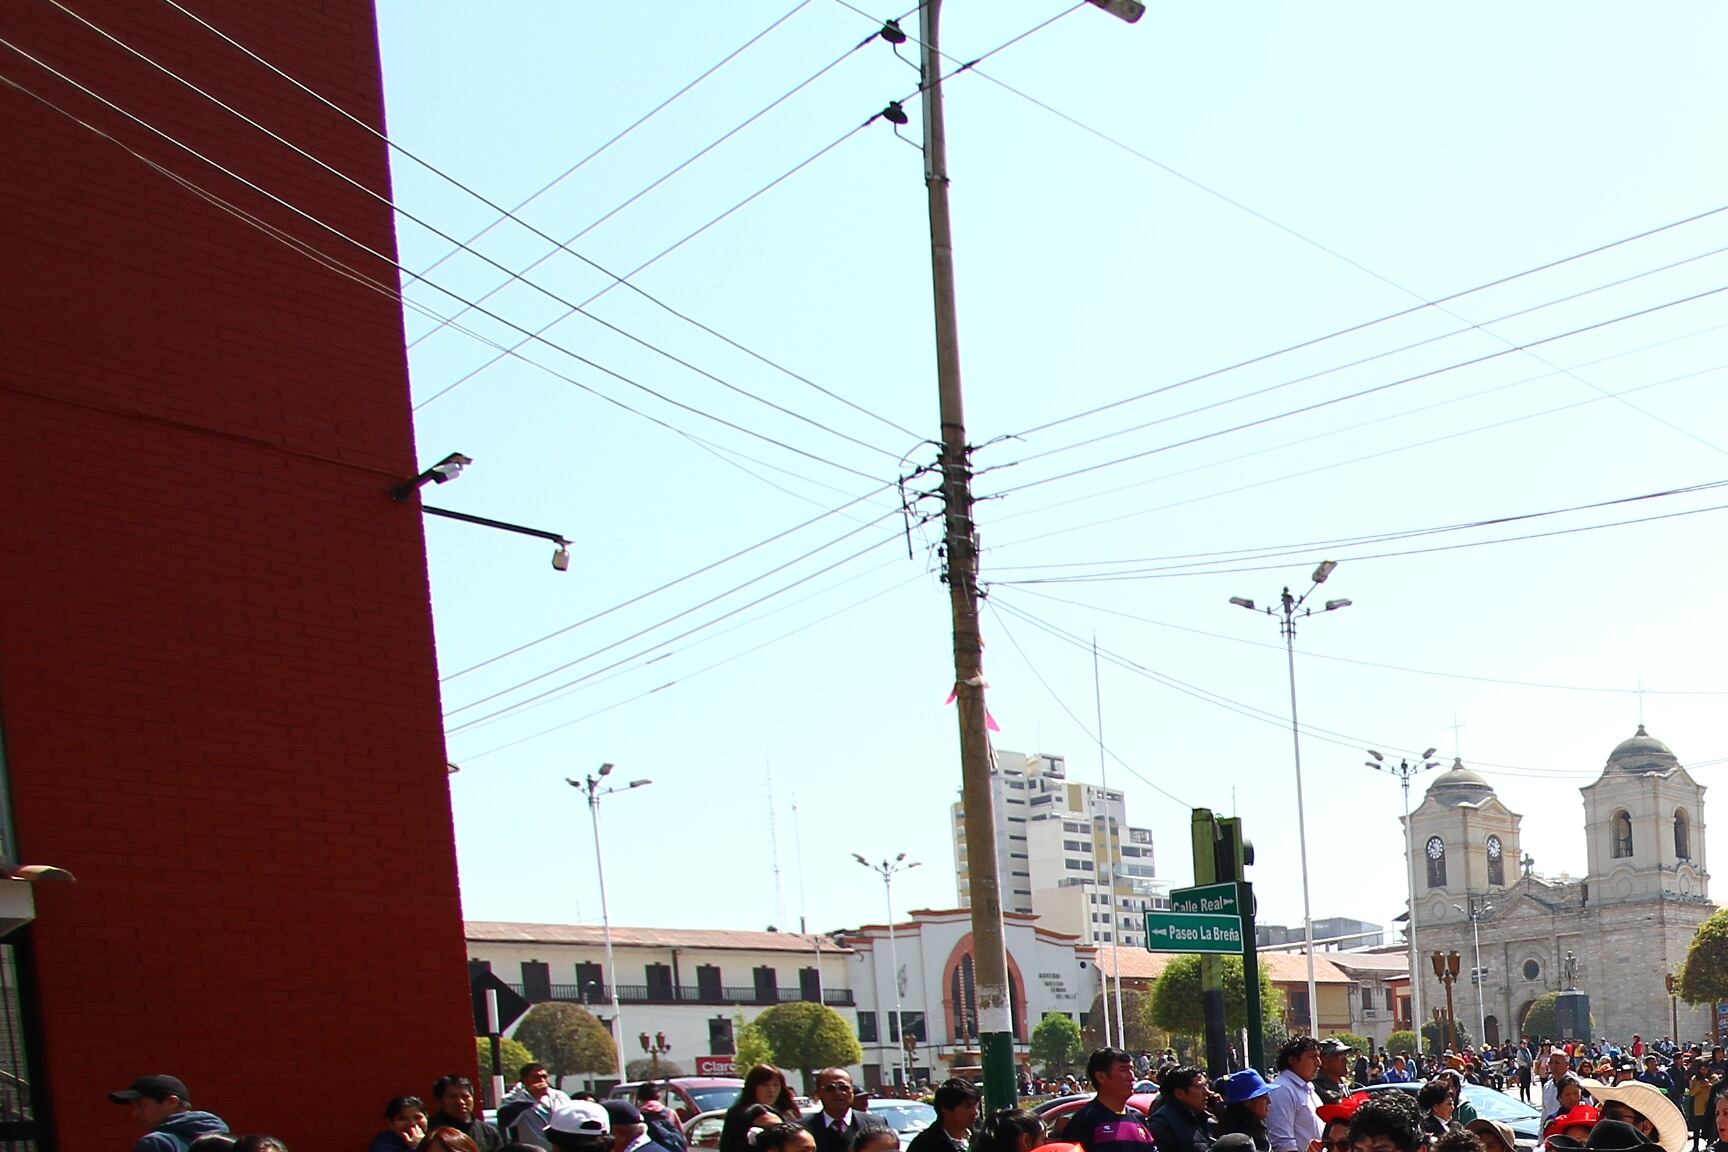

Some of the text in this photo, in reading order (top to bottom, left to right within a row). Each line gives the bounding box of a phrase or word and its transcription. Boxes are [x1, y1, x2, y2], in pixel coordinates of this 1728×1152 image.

[1173, 896, 1224, 913] Calle Real
[1168, 925, 1240, 942] Paseo La Breña
[702, 1061, 737, 1073] Claro
